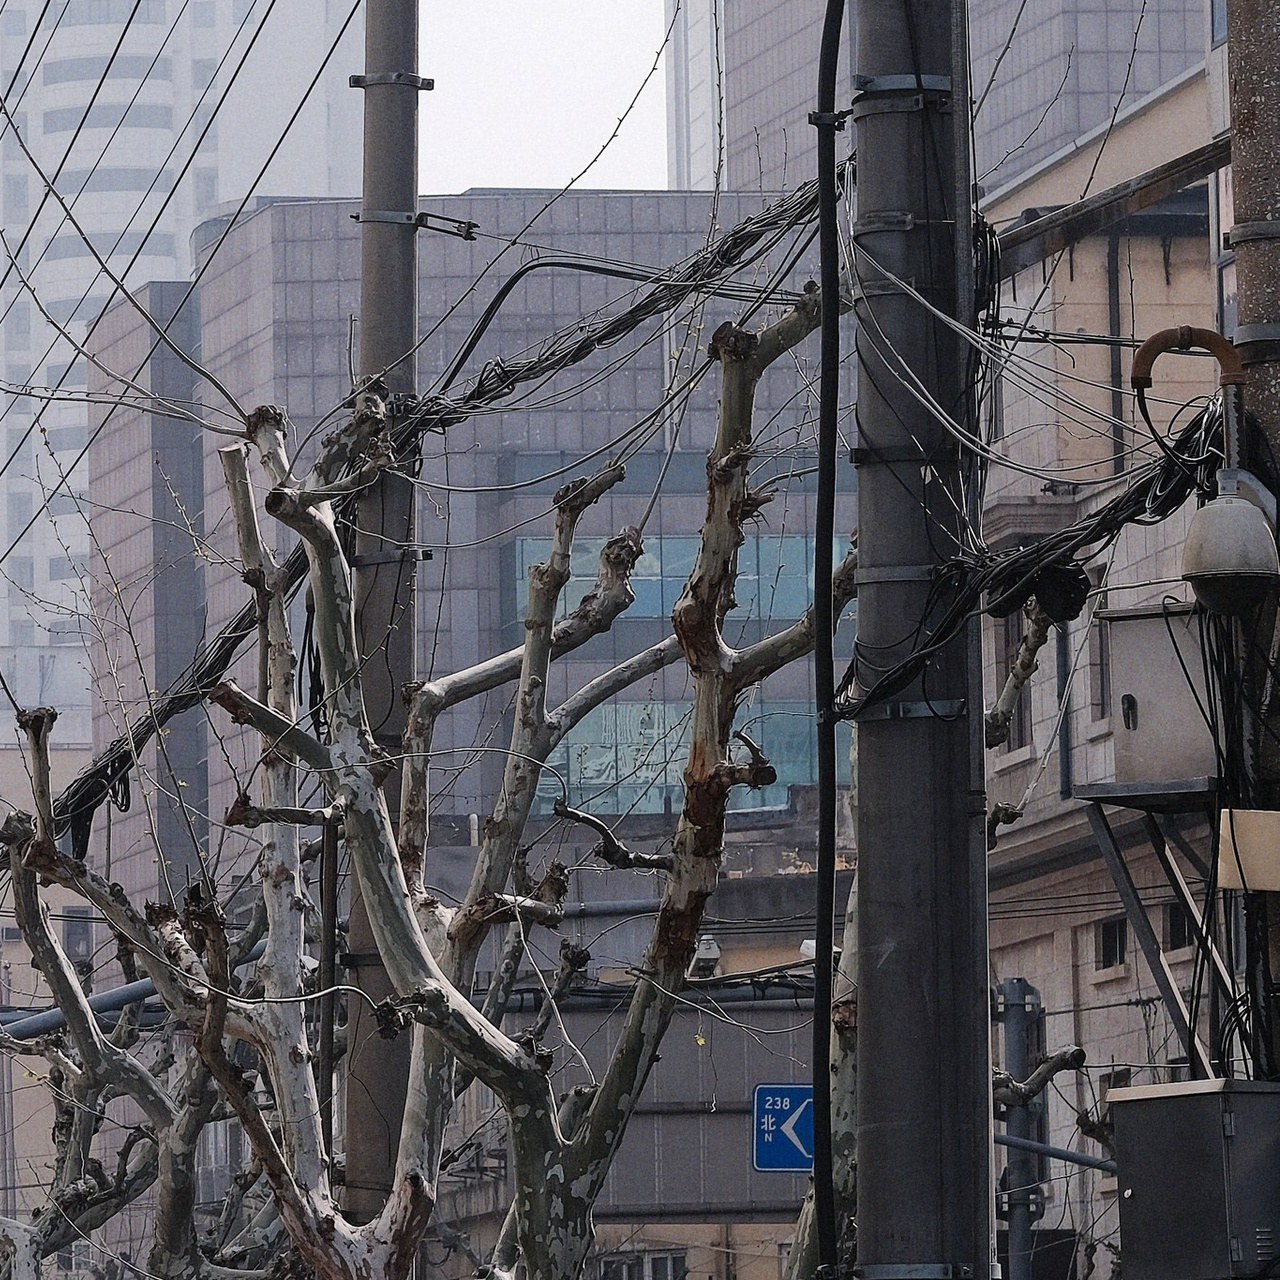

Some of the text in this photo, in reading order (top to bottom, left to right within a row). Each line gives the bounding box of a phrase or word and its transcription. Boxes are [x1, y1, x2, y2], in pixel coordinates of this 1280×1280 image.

[765, 1097, 790, 1110] 238
[761, 1114, 776, 1131] 北
[764, 1133, 772, 1142] N
